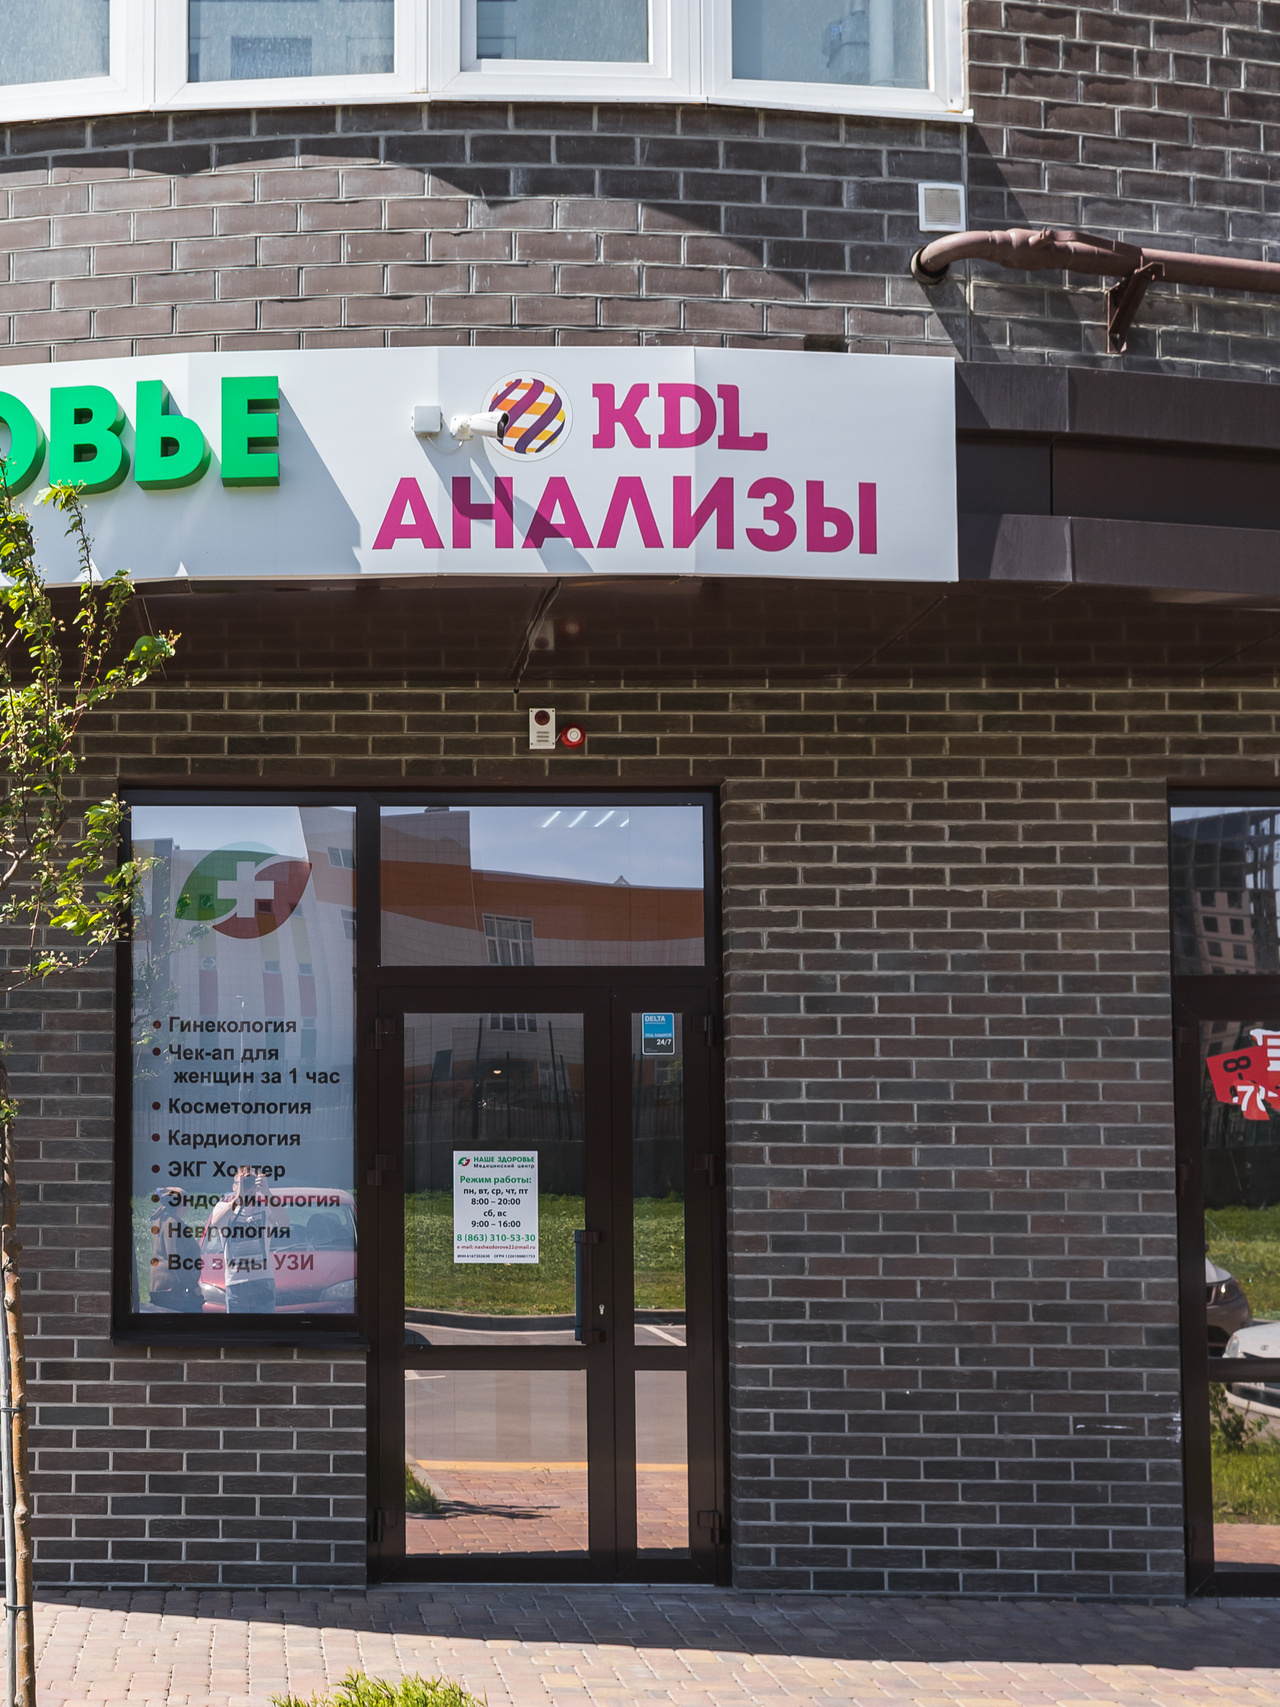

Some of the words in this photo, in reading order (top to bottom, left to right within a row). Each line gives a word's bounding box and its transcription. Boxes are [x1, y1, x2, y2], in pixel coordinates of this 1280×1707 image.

[592, 383, 768, 451] KDL
[372, 476, 878, 554] АНАЛИЗЫ
[169, 1016, 297, 1033] Гинекология
[169, 1044, 235, 1060] Чек-ап
[241, 1047, 279, 1064] для
[173, 1070, 254, 1086] женщин
[261, 1071, 282, 1084] за
[289, 1067, 297, 1084] 1
[306, 1071, 340, 1084] час
[169, 1098, 311, 1115] Косметология
[168, 1130, 301, 1149] Кардиология
[168, 1161, 207, 1177] ЭКГ
[494, 1176, 531, 1185] работы:
[483, 1209, 495, 1217] сб,
[168, 1222, 290, 1242] Неврология
[465, 1234, 487, 1242] (863)
[168, 1254, 205, 1271] Все
[212, 1257, 267, 1275] виды
[274, 1254, 314, 1270] УЗИ
